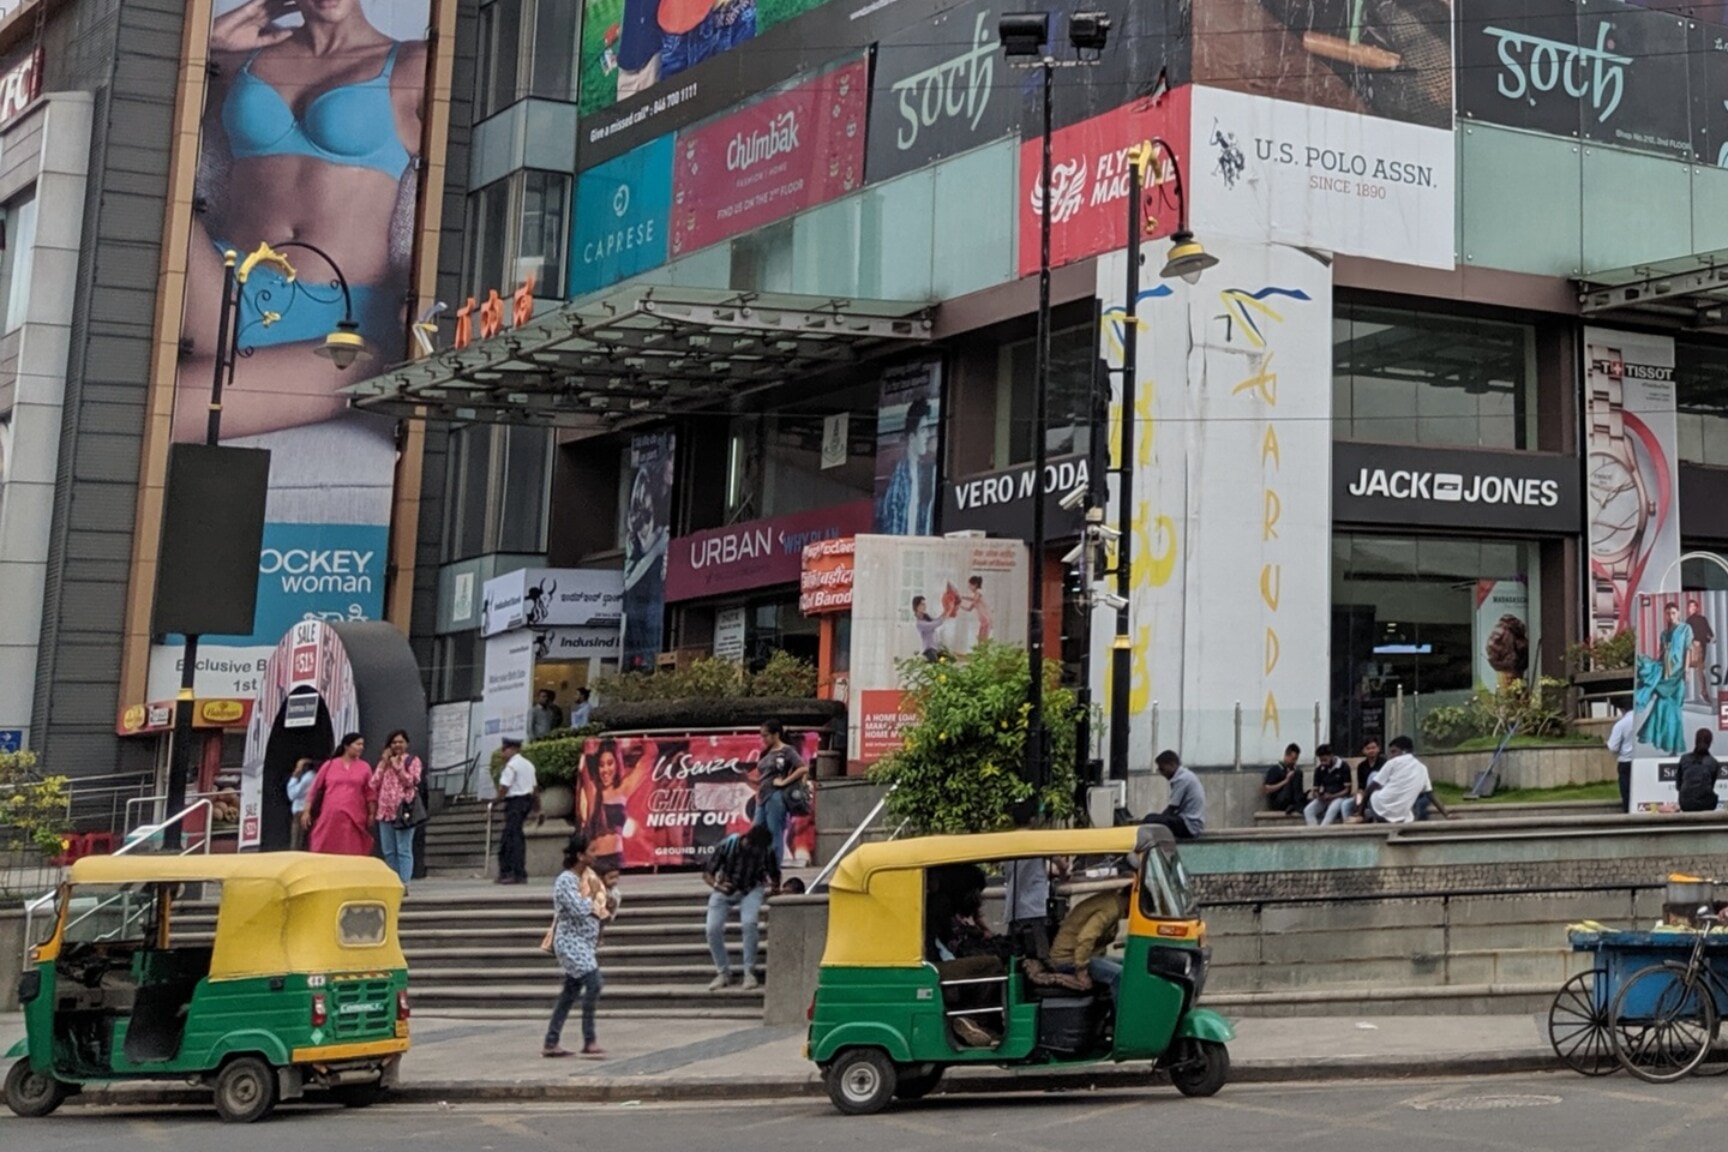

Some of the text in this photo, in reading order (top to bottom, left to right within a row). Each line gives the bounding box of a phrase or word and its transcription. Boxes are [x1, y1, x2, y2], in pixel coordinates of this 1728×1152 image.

[727, 111, 800, 171] Chumbak
[1255, 137, 1438, 189] U.S. POLO ASSN.
[1309, 174, 1386, 201] SINCE 1890
[584, 219, 655, 264] CAPRESE
[1626, 364, 1673, 380] TISSOT
[955, 475, 1014, 510] VERO
[1349, 468, 1558, 507] JACK JONES
[691, 527, 772, 569] URBAN
[1232, 352, 1281, 738] GARUDA
[260, 549, 373, 573] OCKEY
[281, 576, 371, 593] woman
[815, 590, 851, 606] Barod
[561, 637, 614, 648] IndusInd
[176, 659, 251, 673] Eclusive
[233, 680, 256, 692] 1st
[647, 813, 739, 826] NIGHT OUT
[655, 847, 696, 856] GROUND
